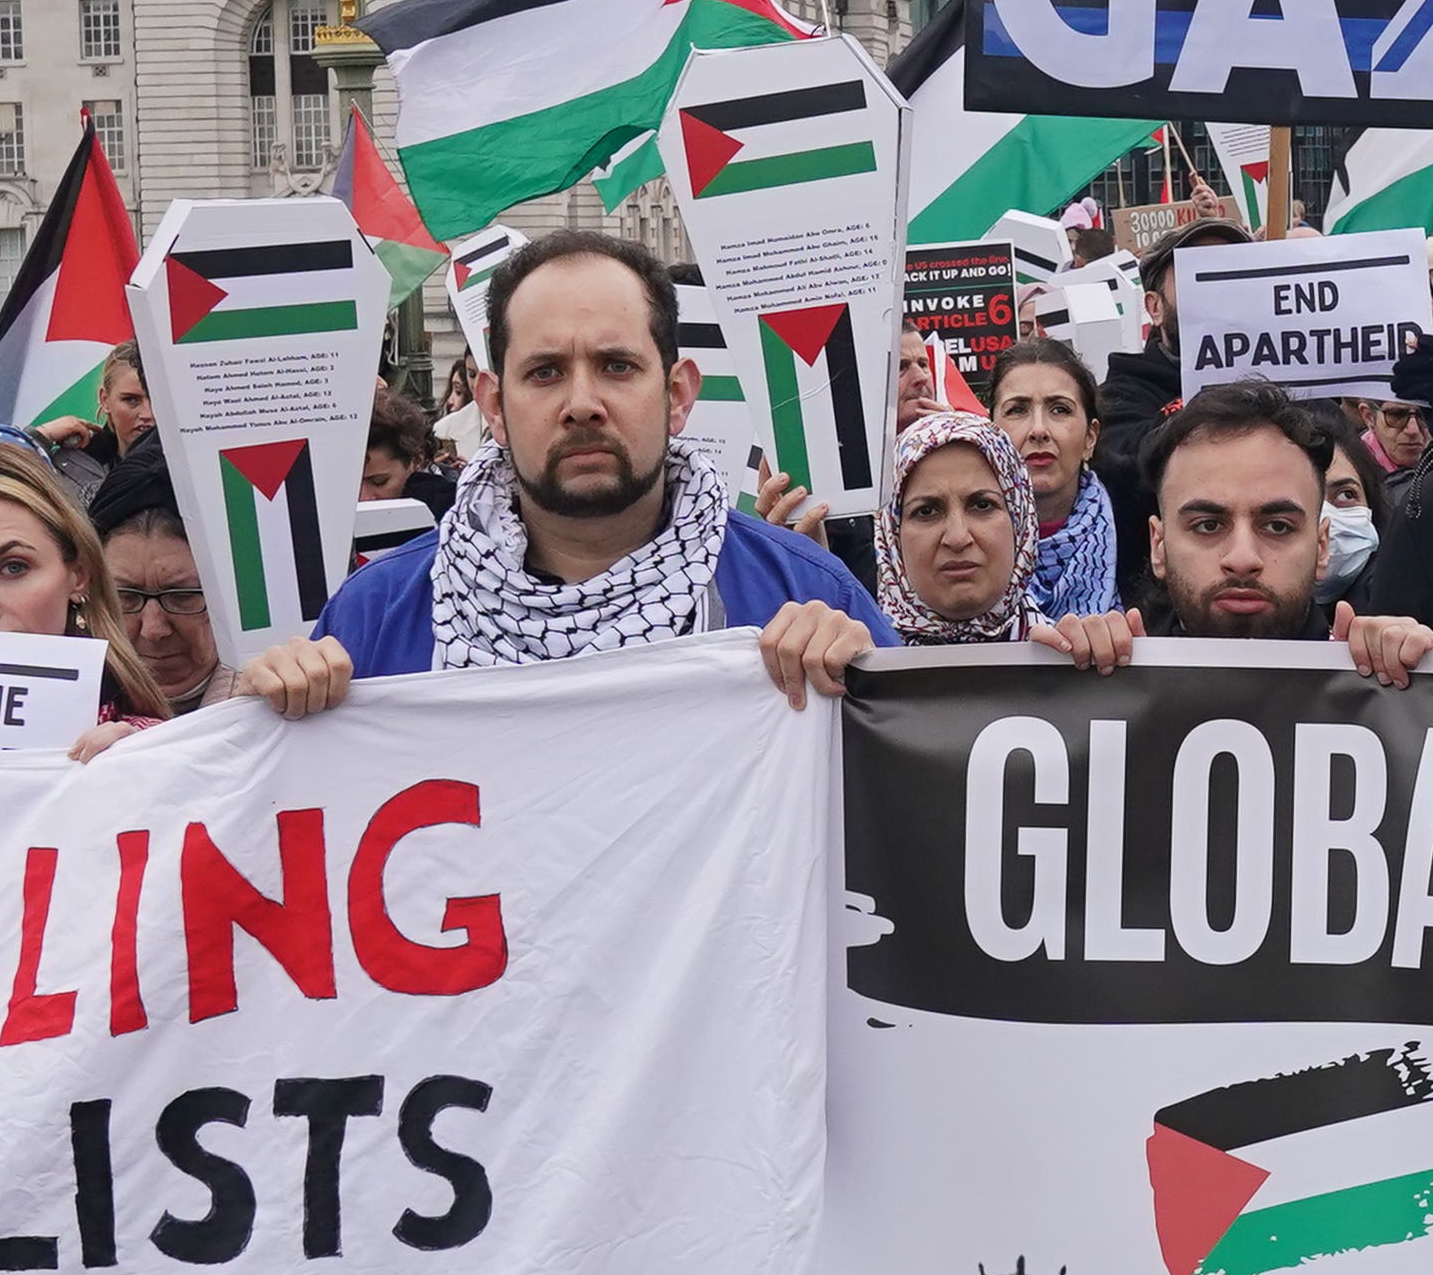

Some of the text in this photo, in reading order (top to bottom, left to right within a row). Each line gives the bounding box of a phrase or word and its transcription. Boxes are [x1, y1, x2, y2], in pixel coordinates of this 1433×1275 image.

[1130, 210, 1175, 234] 30000
[905, 263, 1012, 283] ACK IT UP AND GO!
[903, 294, 985, 313] INVOKE
[988, 293, 1013, 326] 6
[1273, 280, 1340, 316] END
